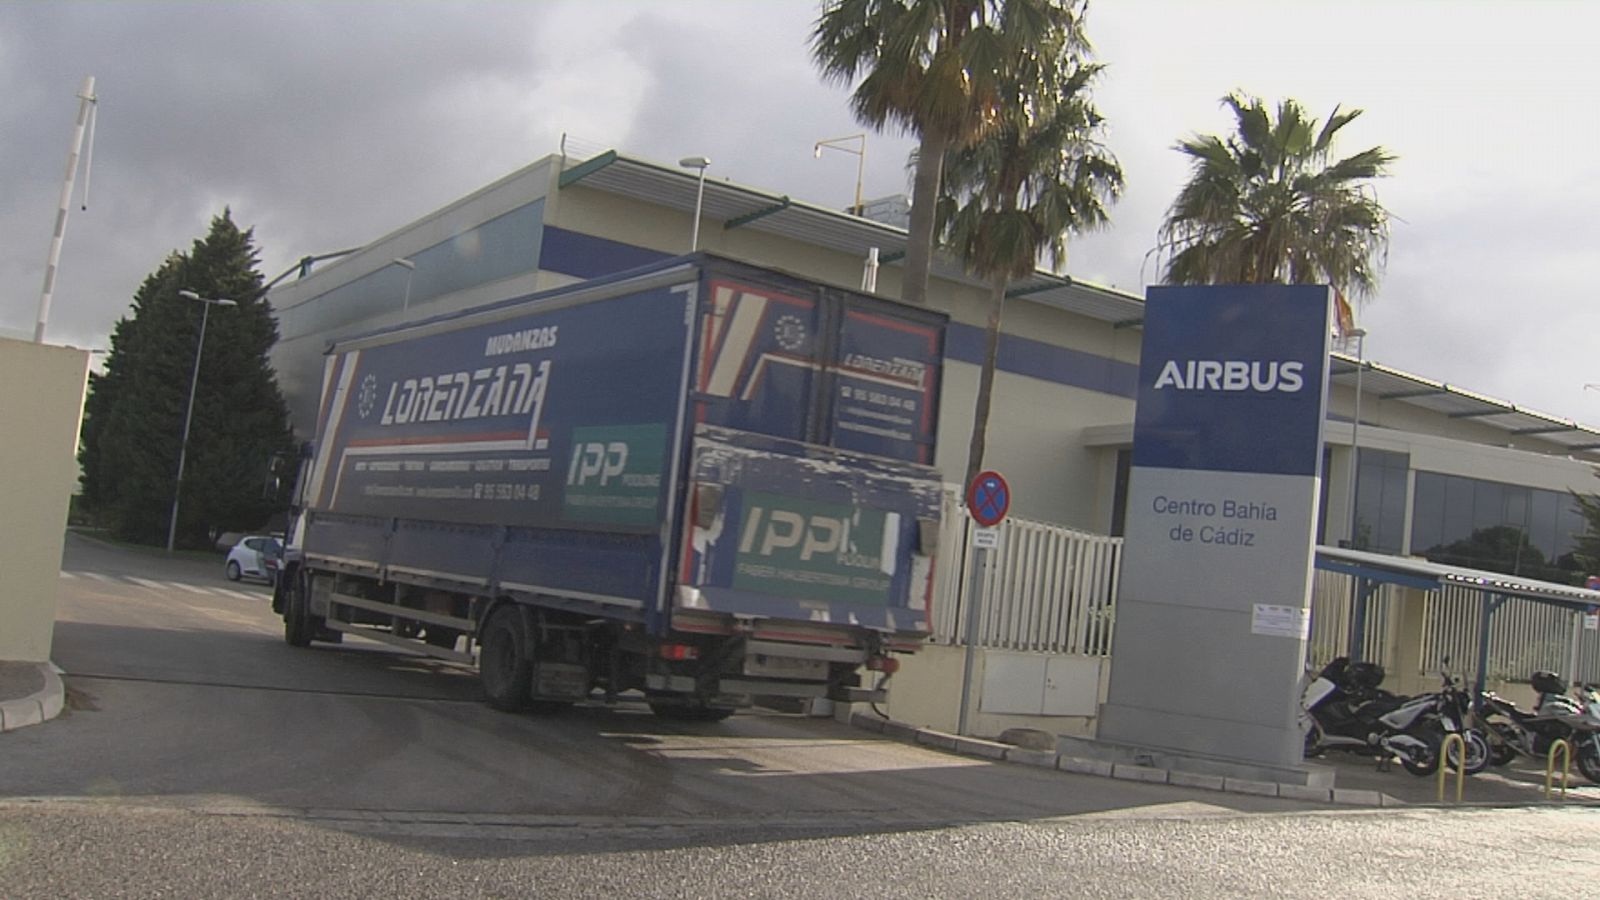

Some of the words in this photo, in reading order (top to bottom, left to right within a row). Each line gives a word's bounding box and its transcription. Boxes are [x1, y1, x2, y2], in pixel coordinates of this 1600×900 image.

[485, 326, 559, 357] MUDANZAS
[1154, 360, 1304, 392] AIRBUS
[380, 360, 552, 448] LORENZANA
[567, 442, 629, 486] IPP
[1153, 495, 1217, 518] Centro
[1223, 499, 1278, 521] Bahía
[738, 507, 844, 561] IPP
[1169, 524, 1193, 542] de
[1199, 525, 1255, 547] Cádiz
